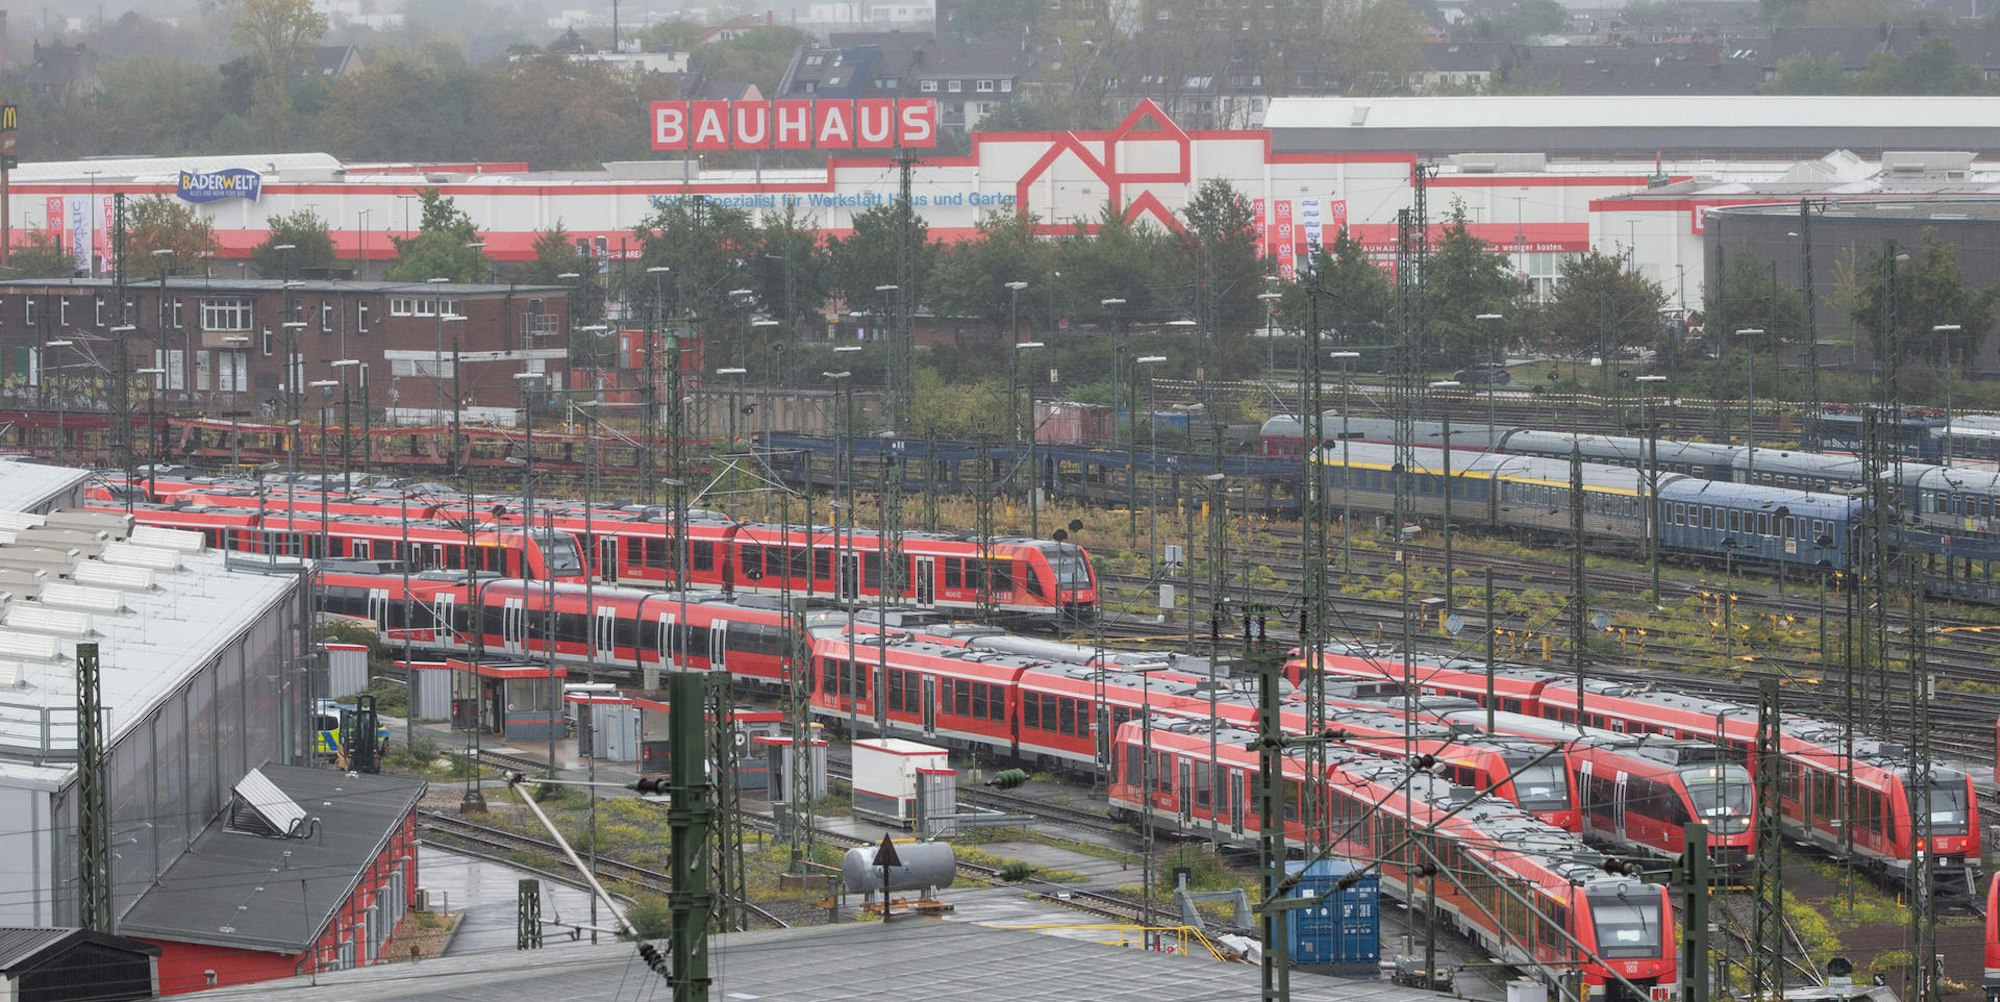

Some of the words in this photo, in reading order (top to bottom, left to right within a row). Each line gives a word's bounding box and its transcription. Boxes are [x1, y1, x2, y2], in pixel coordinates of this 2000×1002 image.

[656, 106, 931, 144] BAUHAUS
[808, 193, 882, 207] Werkstatt
[934, 192, 962, 206] und
